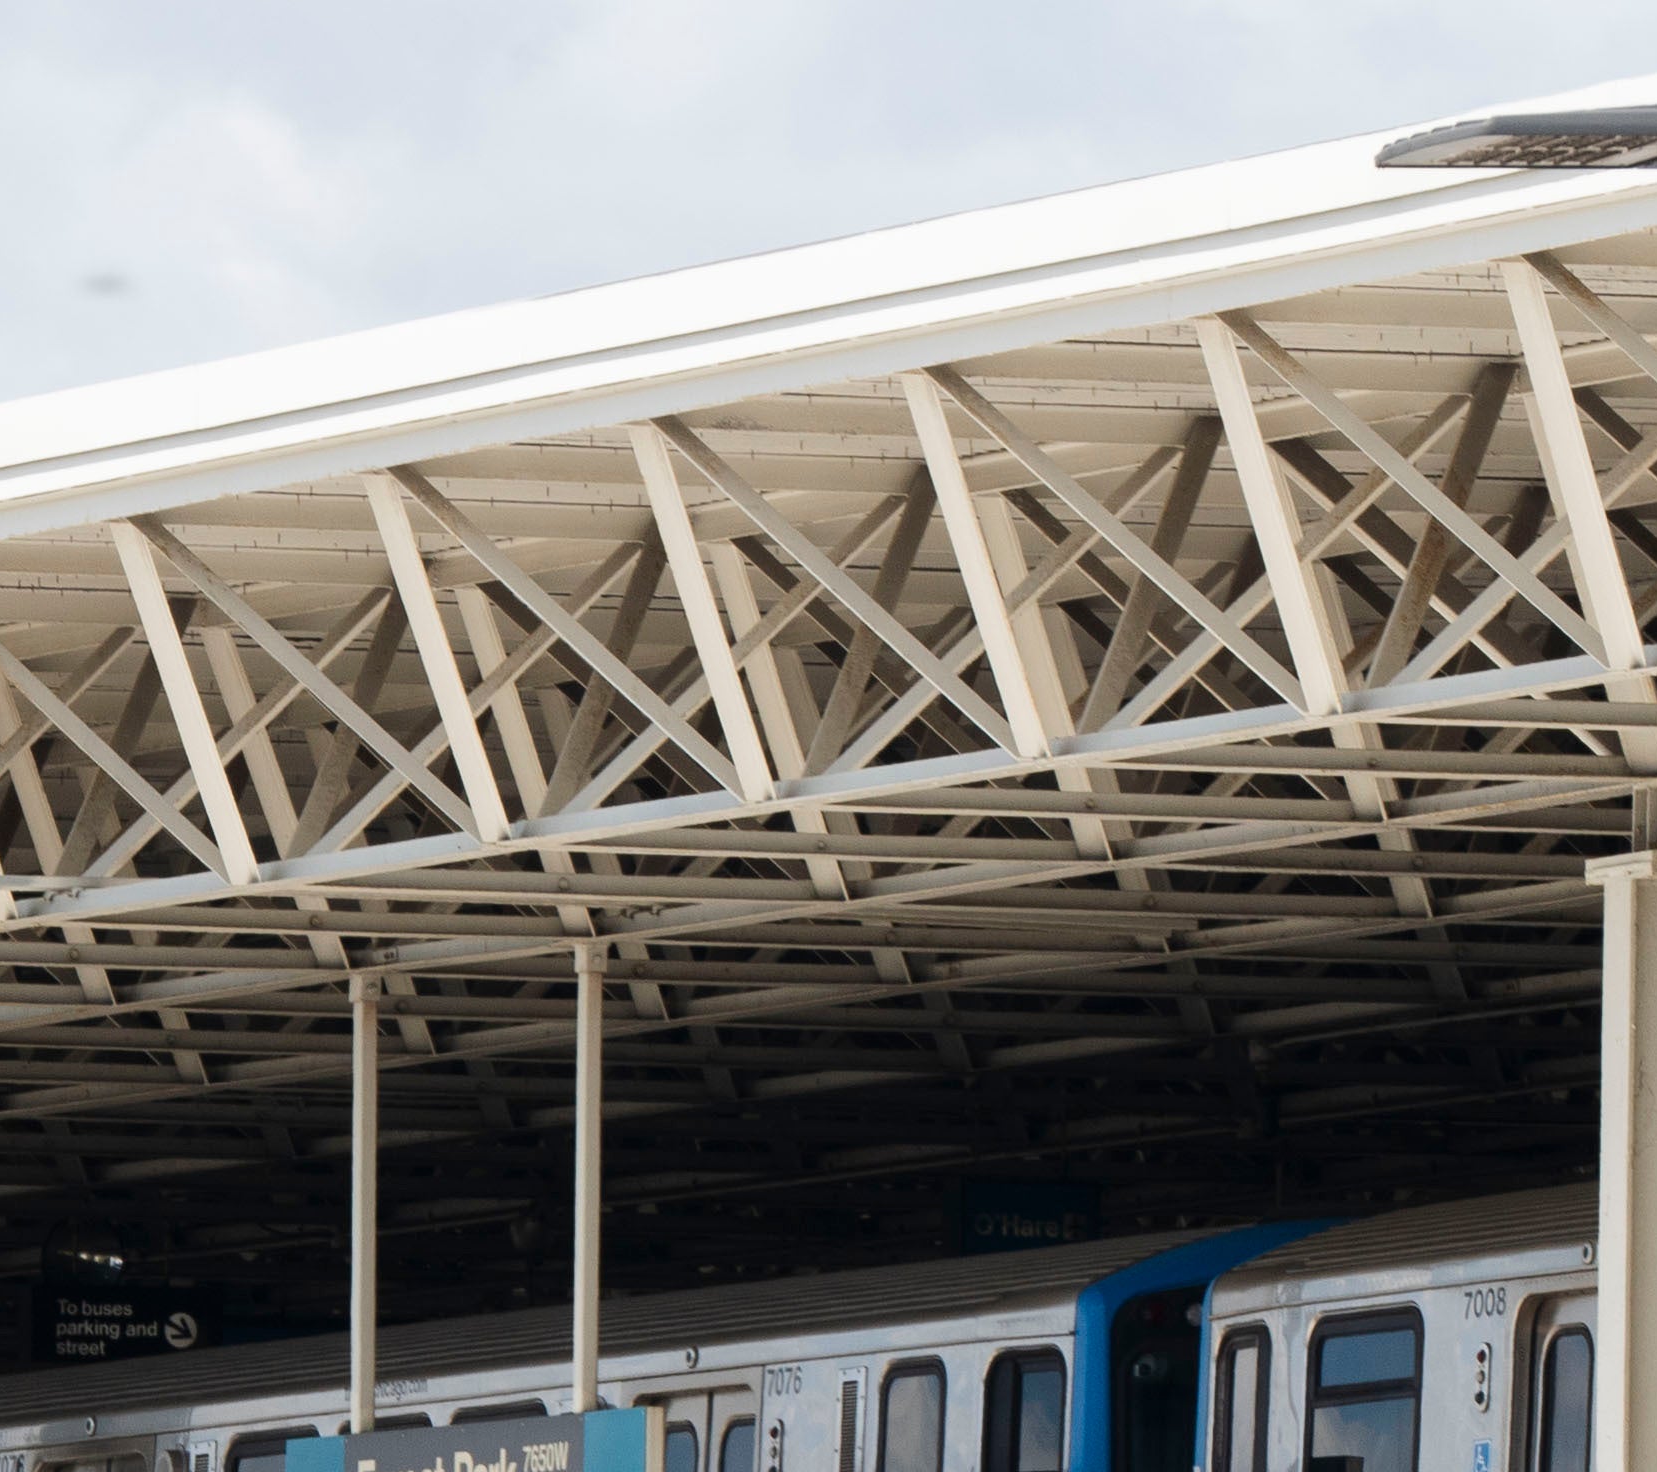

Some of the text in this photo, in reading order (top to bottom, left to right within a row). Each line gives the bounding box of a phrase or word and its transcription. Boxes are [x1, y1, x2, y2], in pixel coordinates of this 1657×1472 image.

[57, 1300, 133, 1317] To buses
[1463, 1285, 1507, 1320] 7008
[56, 1319, 158, 1339] parking and
[56, 1338, 105, 1356] street
[766, 1365, 803, 1397] 7076
